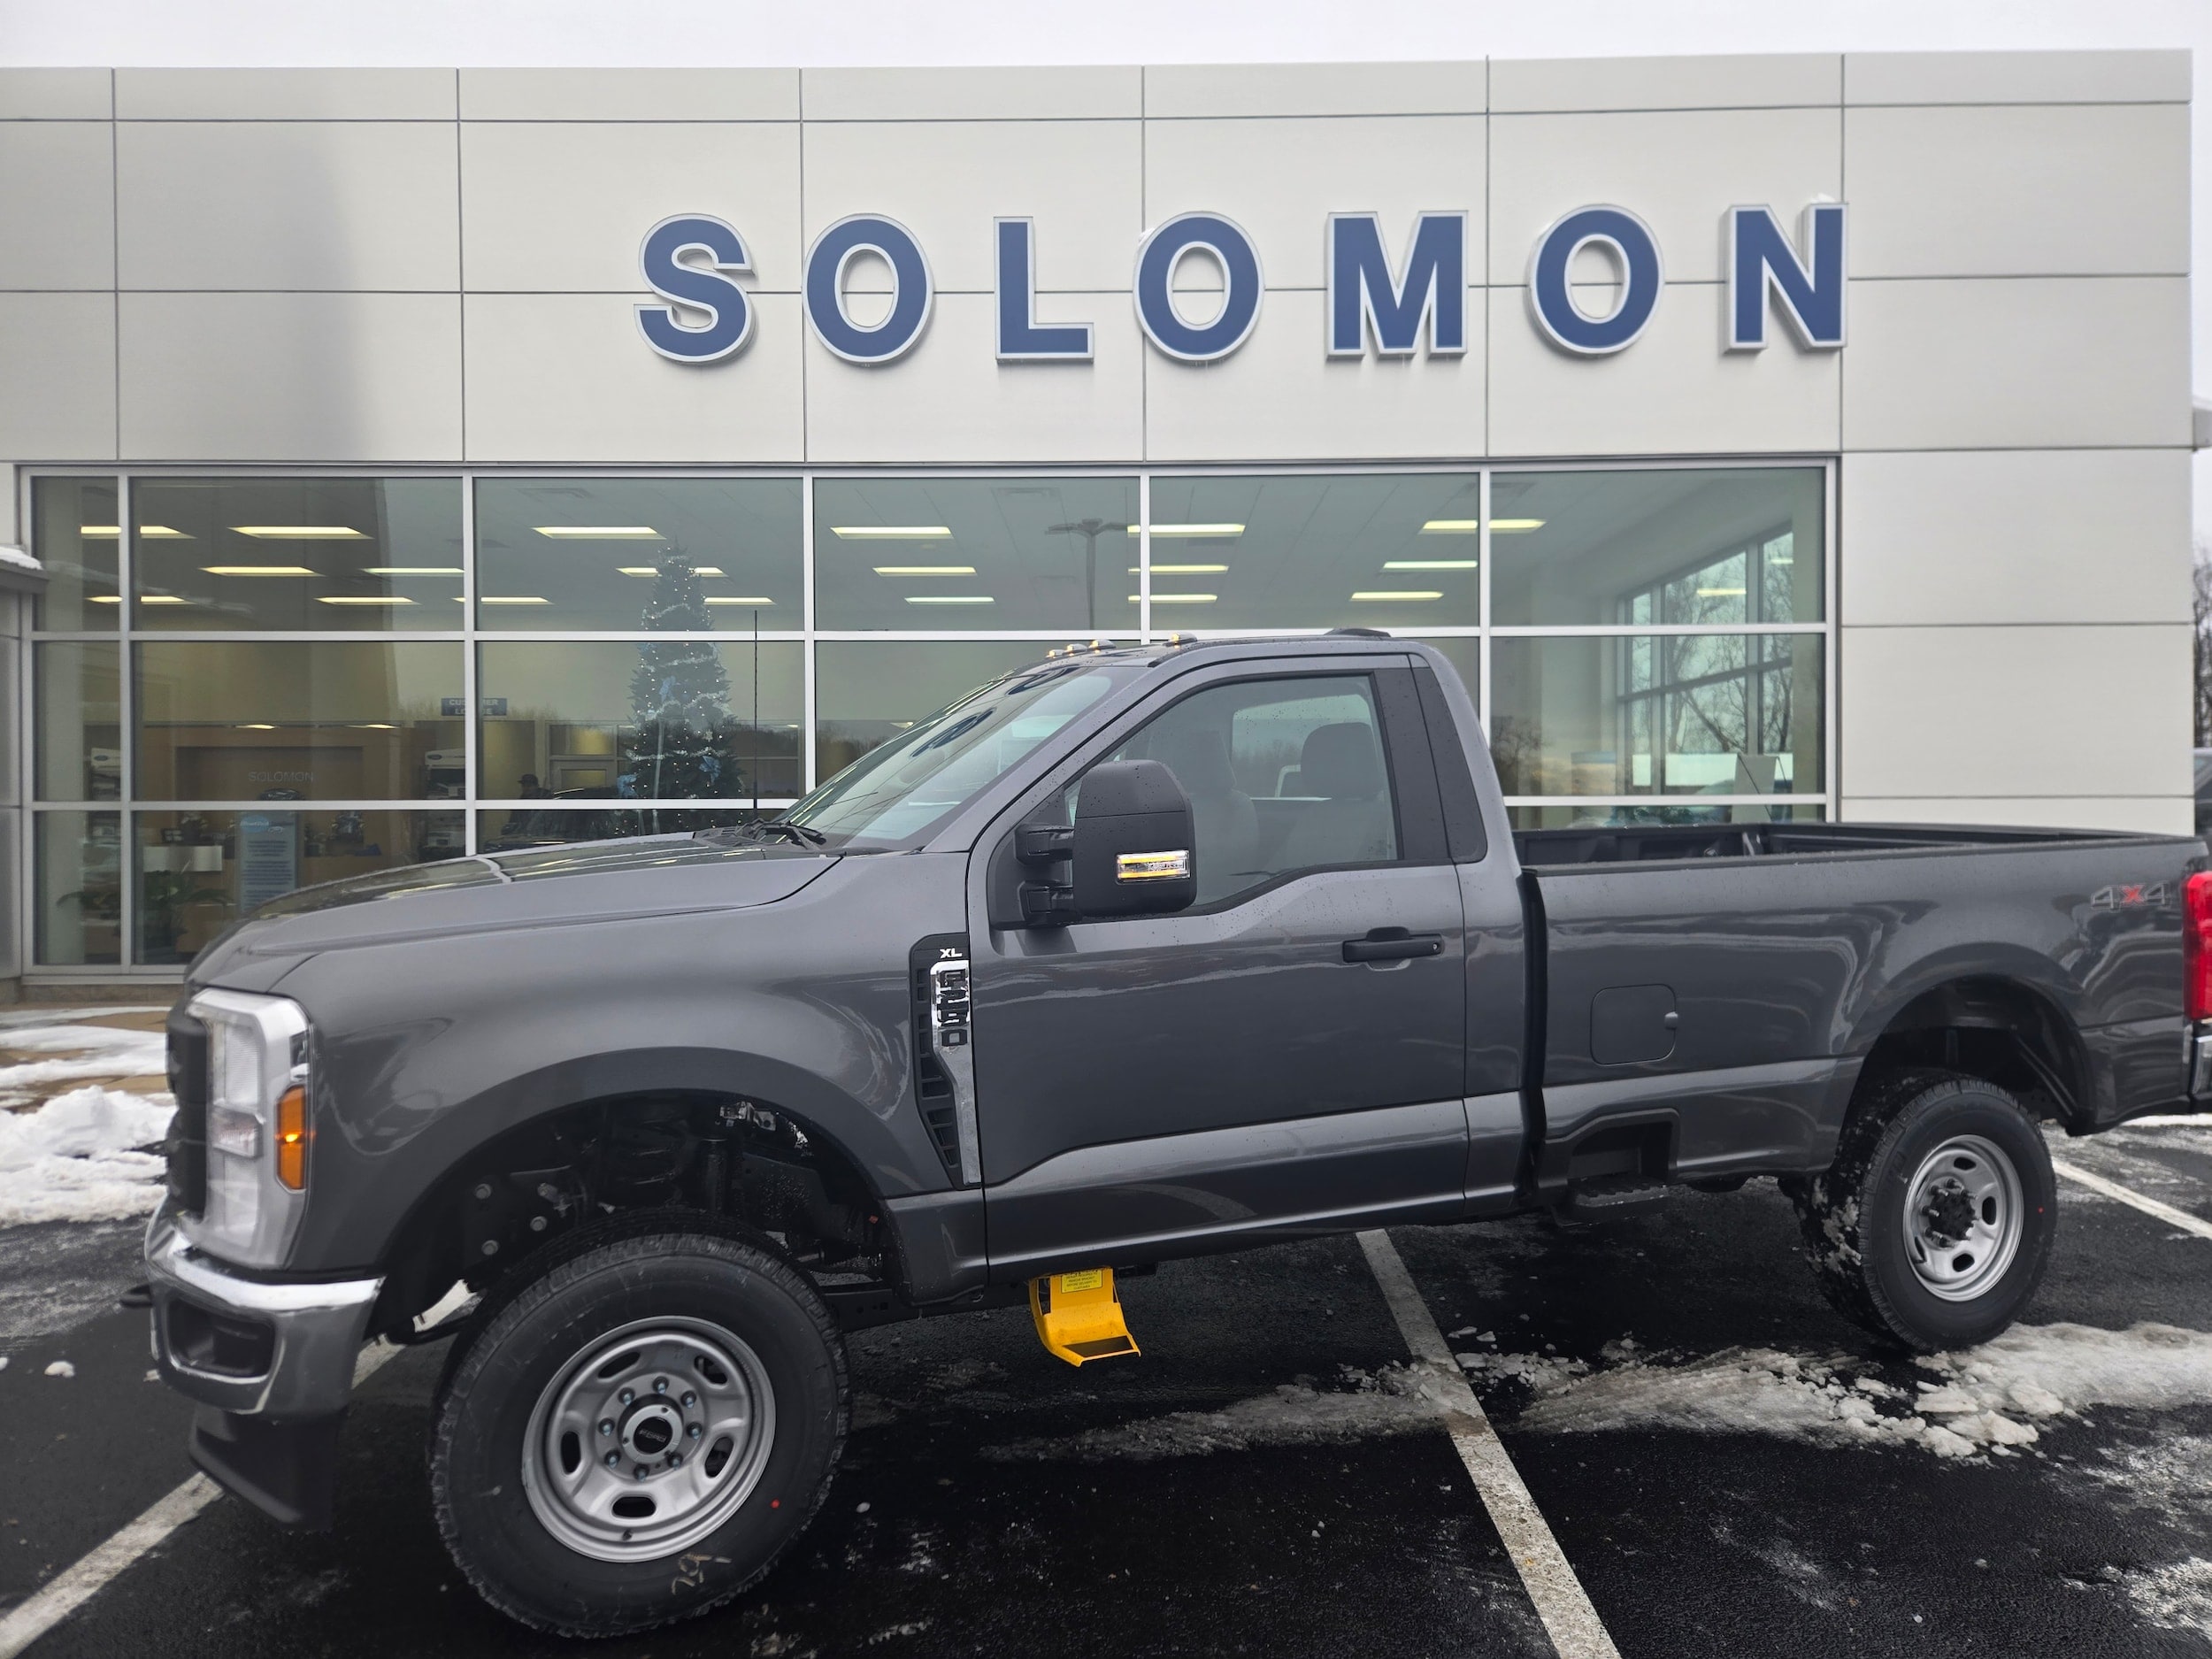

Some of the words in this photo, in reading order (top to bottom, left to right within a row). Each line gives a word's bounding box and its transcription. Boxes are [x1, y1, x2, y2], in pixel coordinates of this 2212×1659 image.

[634, 203, 1848, 365] SOLOMON
[249, 771, 314, 782] SOLOMON
[940, 948, 963, 959] XL
